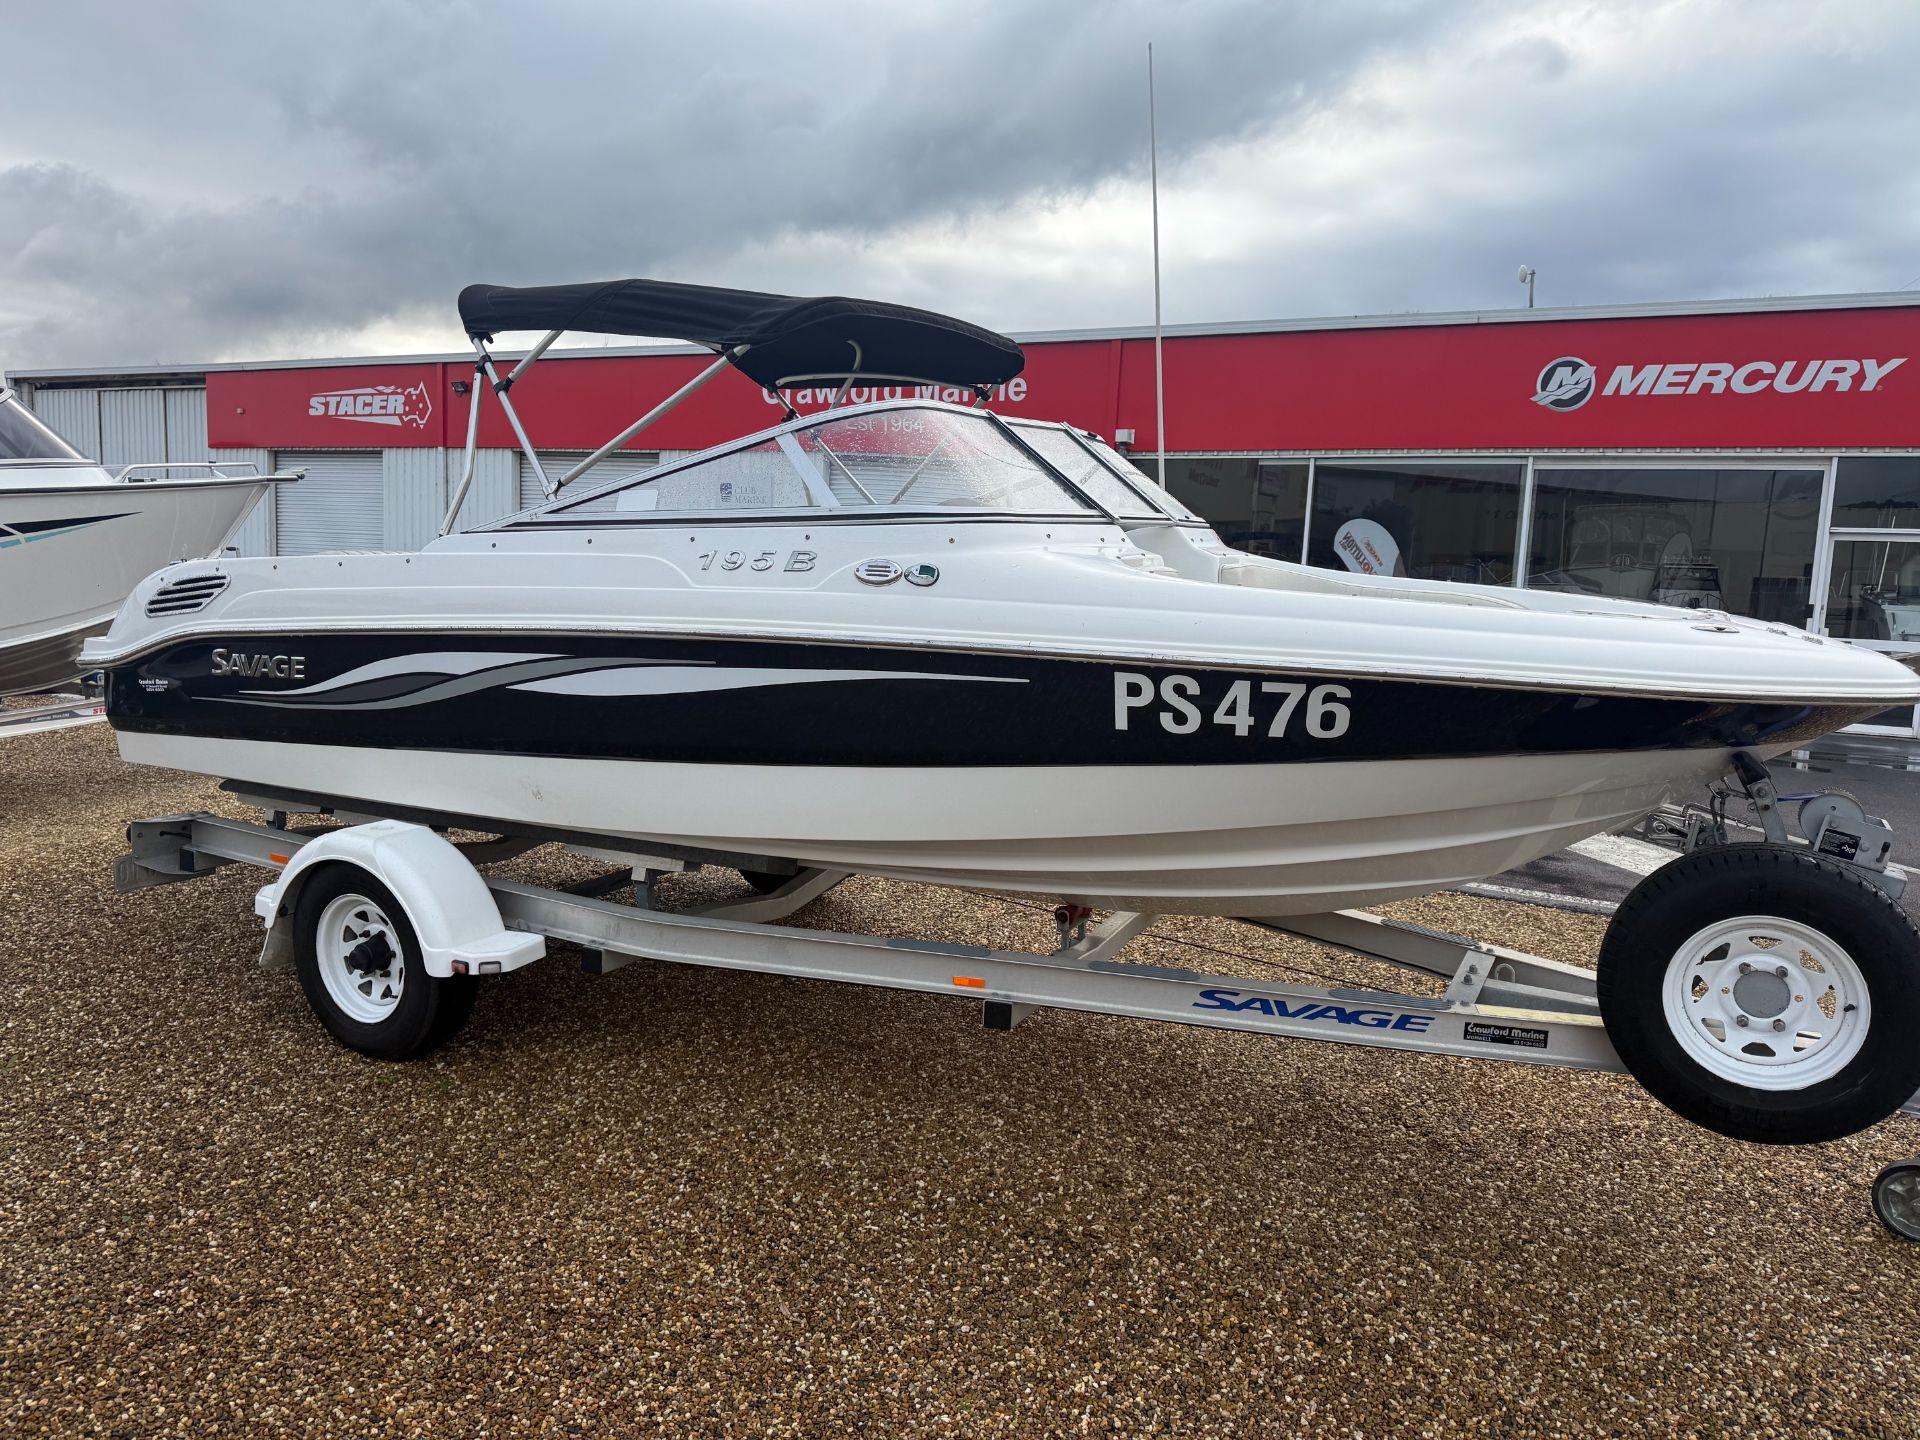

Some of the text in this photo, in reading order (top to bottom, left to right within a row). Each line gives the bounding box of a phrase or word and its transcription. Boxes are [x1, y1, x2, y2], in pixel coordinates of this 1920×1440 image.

[914, 378, 1027, 402] Mare
[1601, 358, 1909, 396] MERCURY
[308, 394, 405, 416] STACER
[882, 414, 925, 434] 1964
[211, 648, 306, 680] SAVAGE
[1114, 671, 1352, 739] PS 476
[1192, 989, 1436, 1033] SAVAGE
[1467, 1022, 1545, 1040] Crawford Marine
